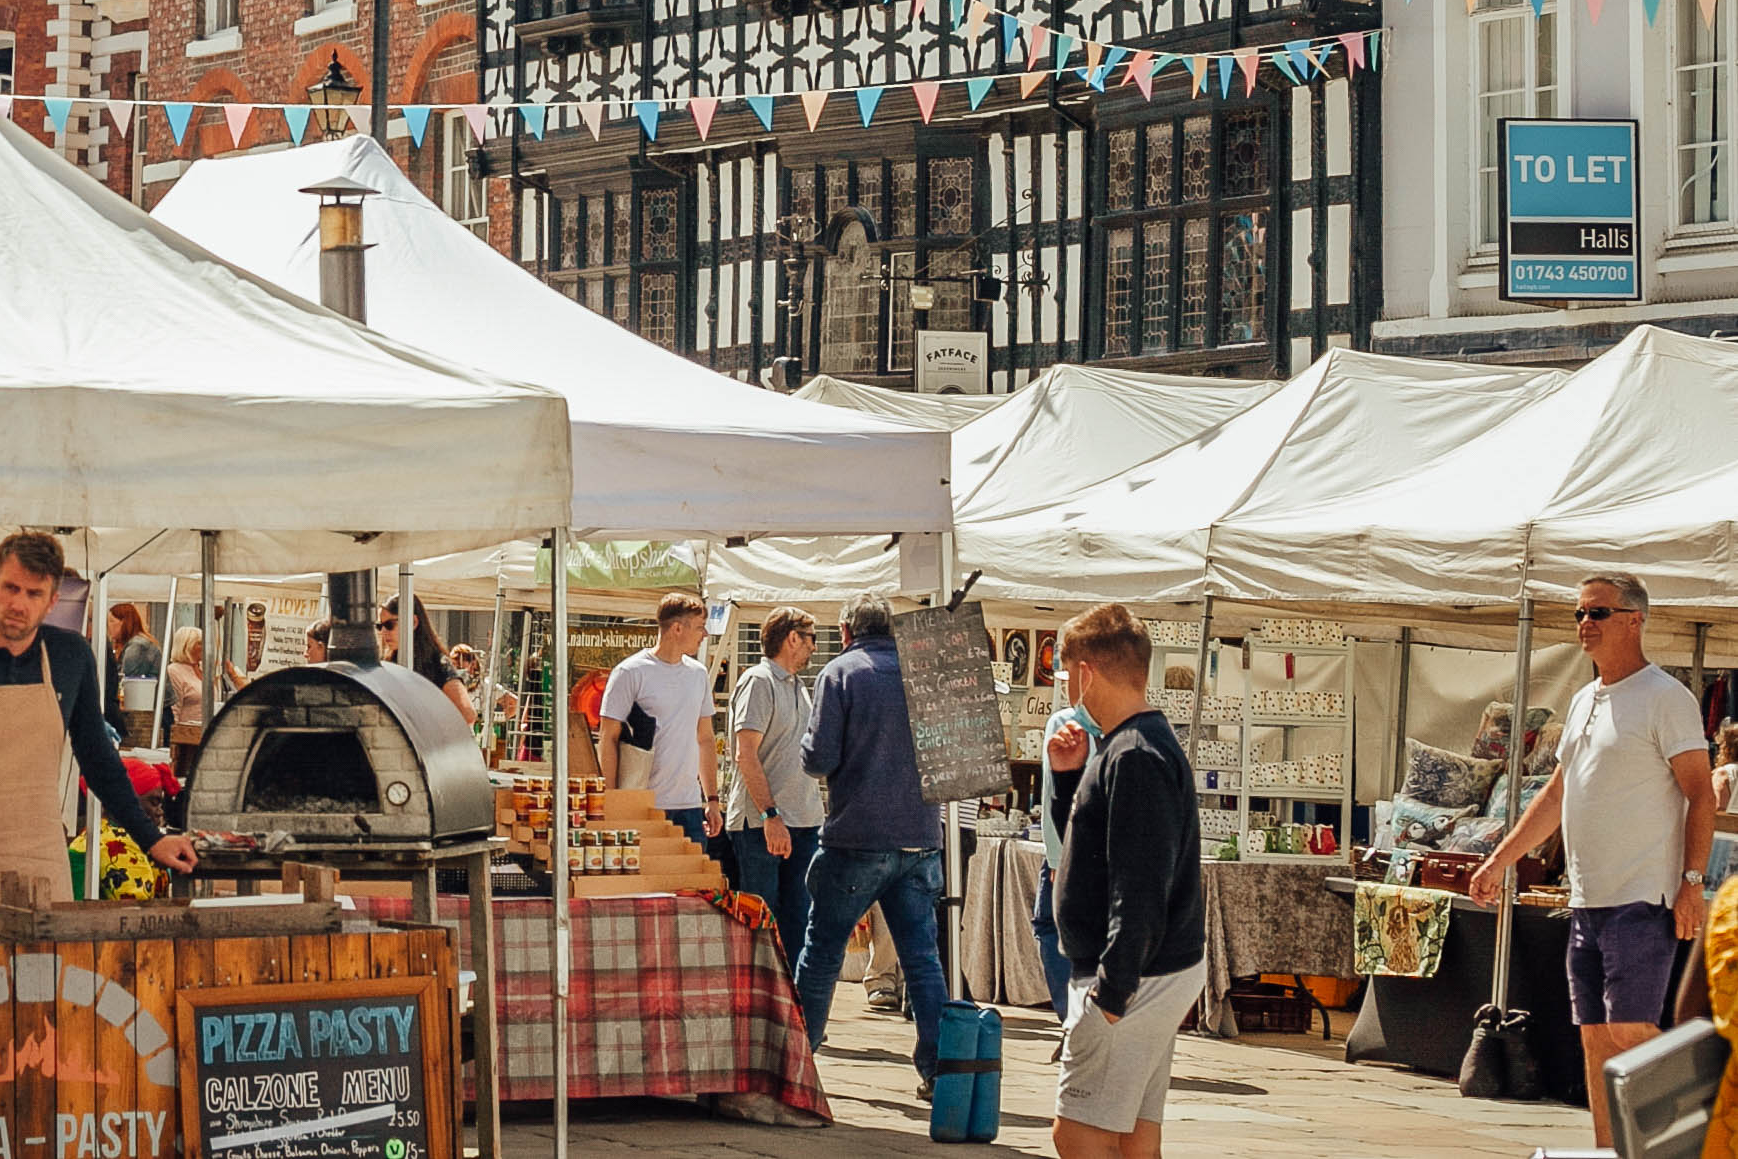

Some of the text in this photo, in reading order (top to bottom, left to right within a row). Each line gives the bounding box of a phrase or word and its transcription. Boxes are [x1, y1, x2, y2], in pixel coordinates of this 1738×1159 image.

[1514, 155, 1627, 183] TO LET
[1580, 228, 1629, 249] Halls
[1515, 265, 1627, 280] 01743 450700
[926, 348, 978, 364] FATFACE
[278, 597, 307, 615] LOVE
[1027, 697, 1052, 715] Glas
[202, 1006, 414, 1064] PIZZA PASTY
[205, 1066, 410, 1113] CALZONE MENU
[57, 1111, 166, 1159] PASTY
[351, 1140, 379, 1157] Peppers
